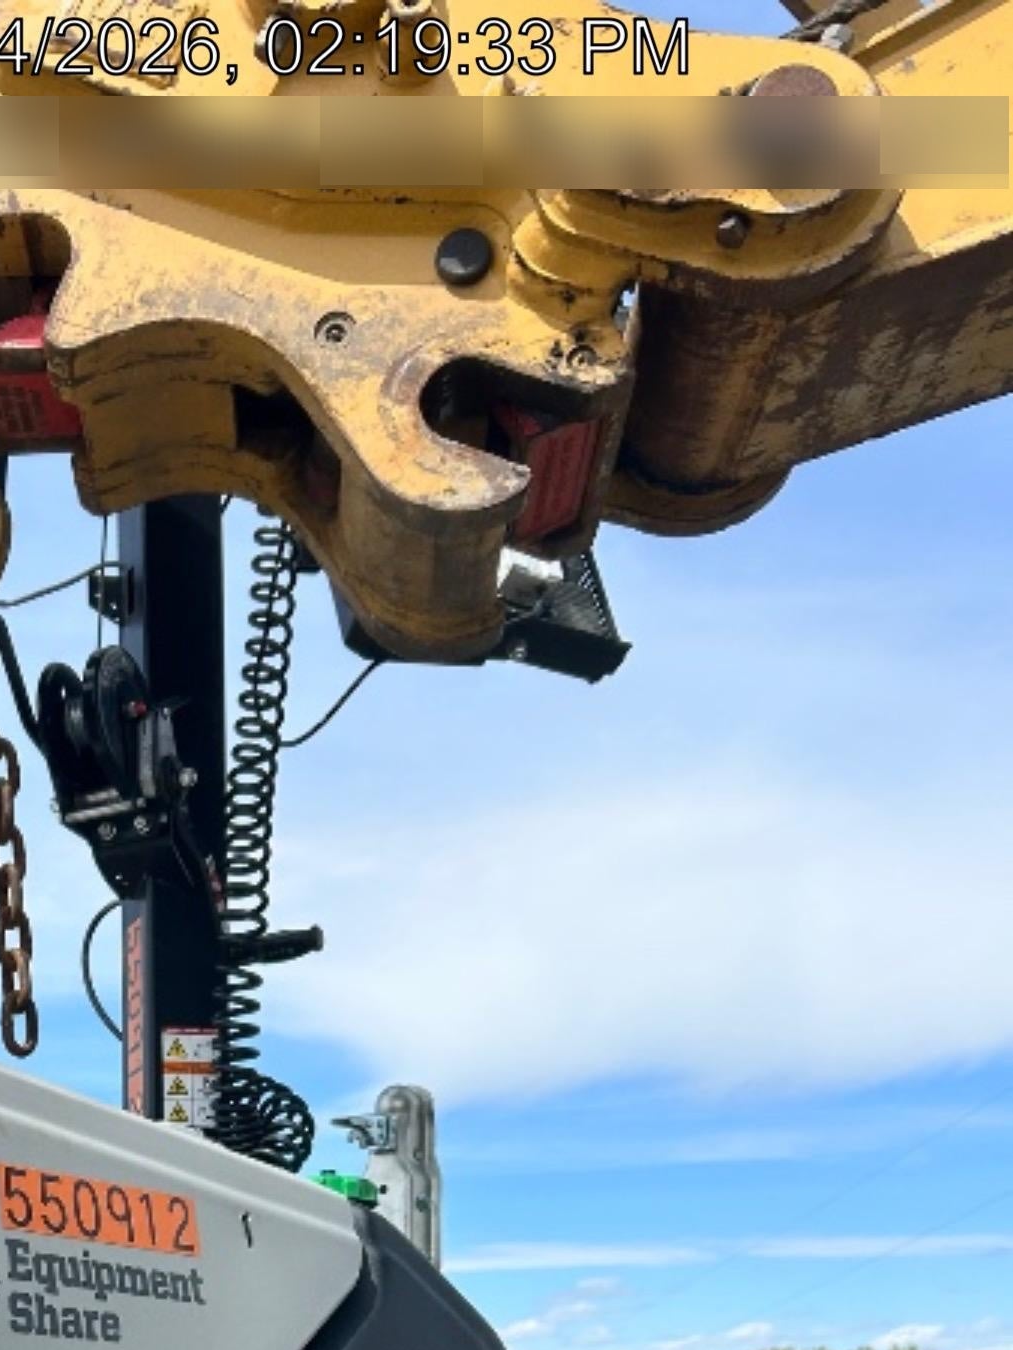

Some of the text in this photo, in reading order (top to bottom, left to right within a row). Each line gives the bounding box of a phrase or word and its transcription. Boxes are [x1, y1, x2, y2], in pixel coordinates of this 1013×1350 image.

[3, 1166, 195, 1252] 550912
[5, 1238, 206, 1305] Equipment
[9, 1291, 122, 1342] Share
